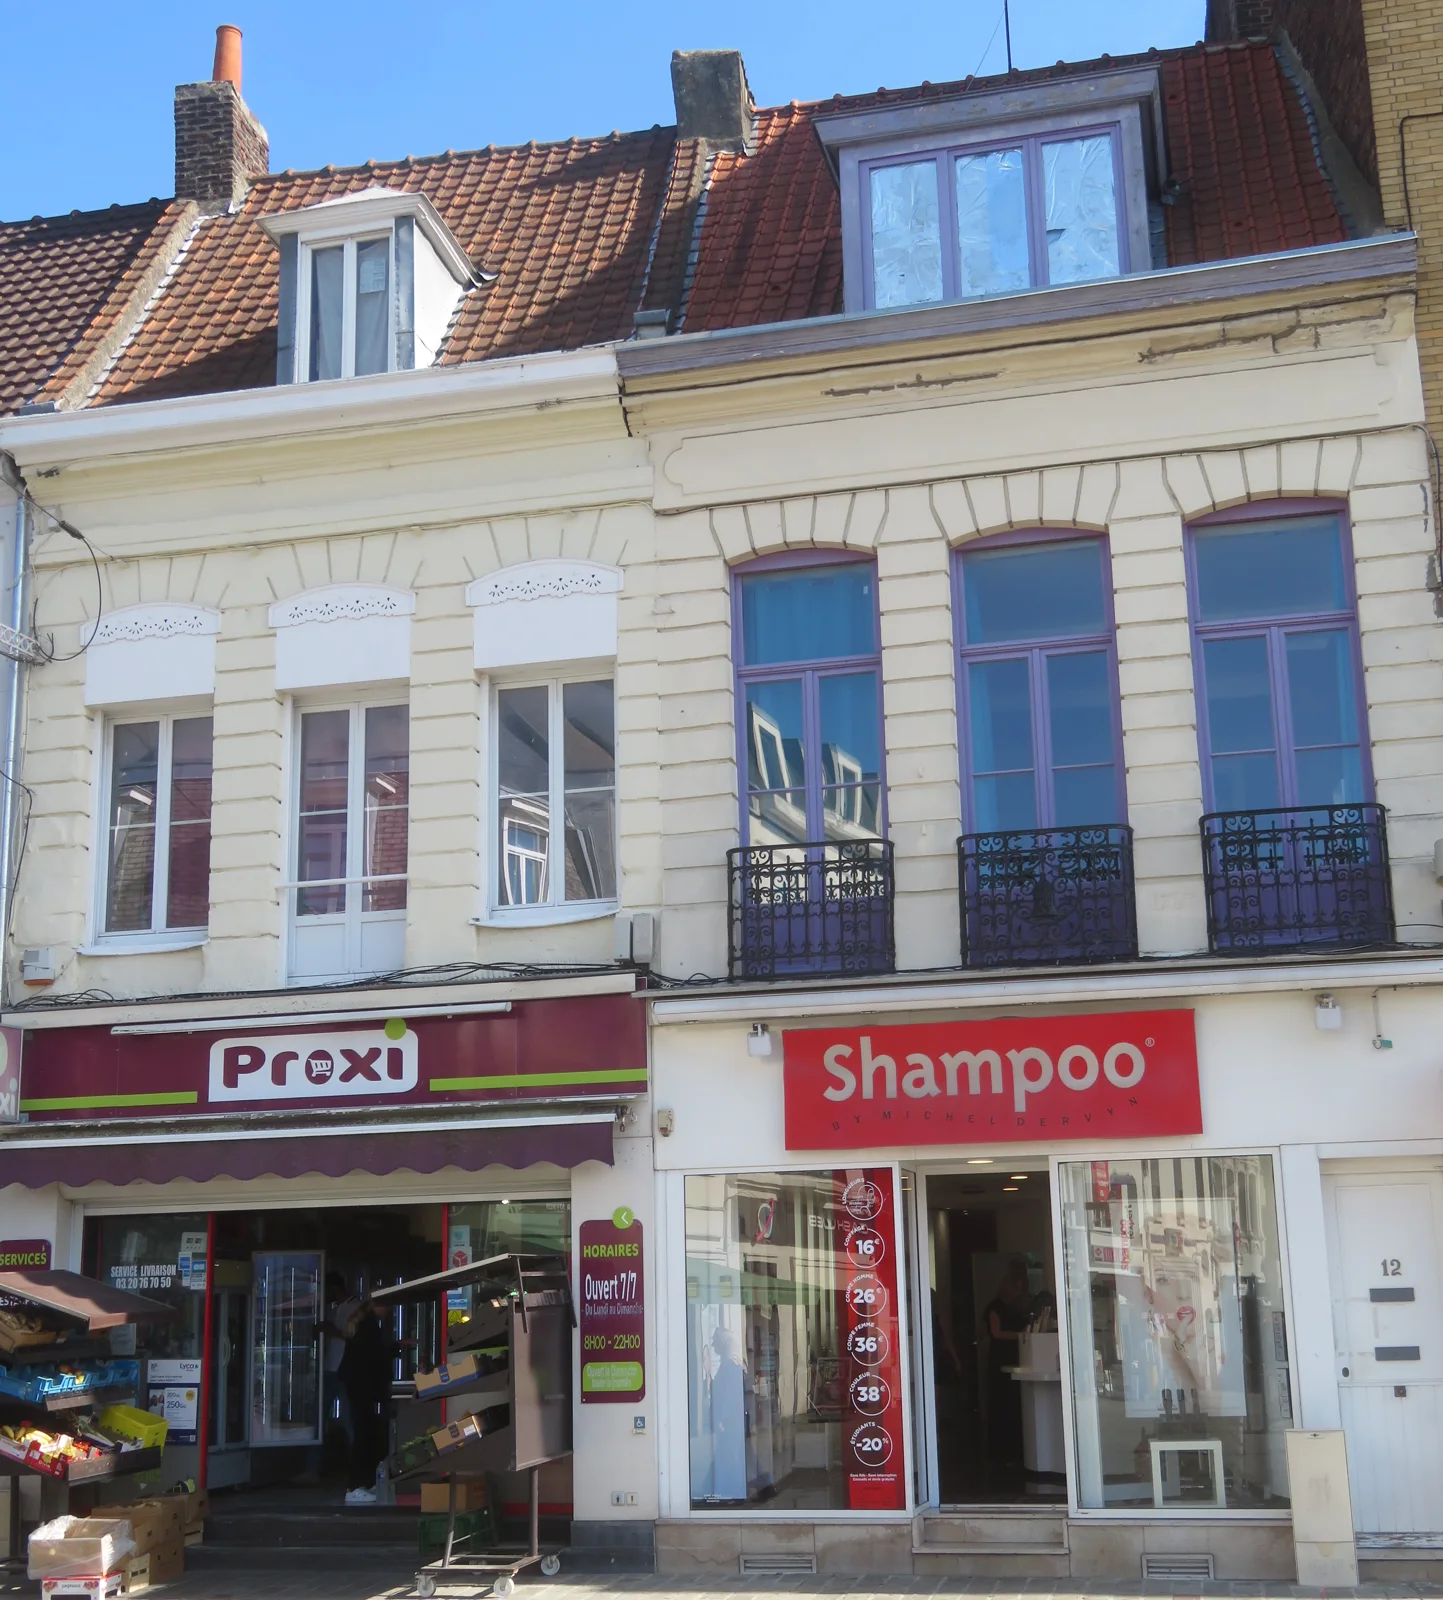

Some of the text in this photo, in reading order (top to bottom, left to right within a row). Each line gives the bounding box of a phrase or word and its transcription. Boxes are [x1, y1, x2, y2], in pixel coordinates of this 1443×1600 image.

[223, 1018, 407, 1089] Proxi
[832, 1097, 1139, 1131] BY MICHEL DERVYN
[842, 1177, 865, 1204] LONGUEURS
[844, 1225, 865, 1247] COIFFAGE
[0, 1252, 47, 1266] SERVICES
[583, 1243, 639, 1258] HORAIRES
[110, 1264, 176, 1278] SERVICE LIVRAISON
[1381, 1259, 1402, 1276] 12
[116, 1278, 127, 1288] 03
[127, 1278, 138, 1288] 20
[139, 1277, 149, 1288] 76
[150, 1277, 159, 1288] 70
[160, 1277, 171, 1288] 50
[585, 1270, 637, 1301] Ouvert 7/7
[845, 1274, 874, 1303] COUPE HOMME
[585, 1303, 593, 1316] Du
[593, 1303, 609, 1316] Lundi
[584, 1335, 606, 1350] 8H00
[613, 1335, 640, 1350] 22H00
[847, 1322, 875, 1351] COUPE FEMME
[180, 1363, 194, 1371] Lyca
[849, 1371, 871, 1393] COULEUR
[850, 1422, 876, 1445] ÉTUDIANTS
